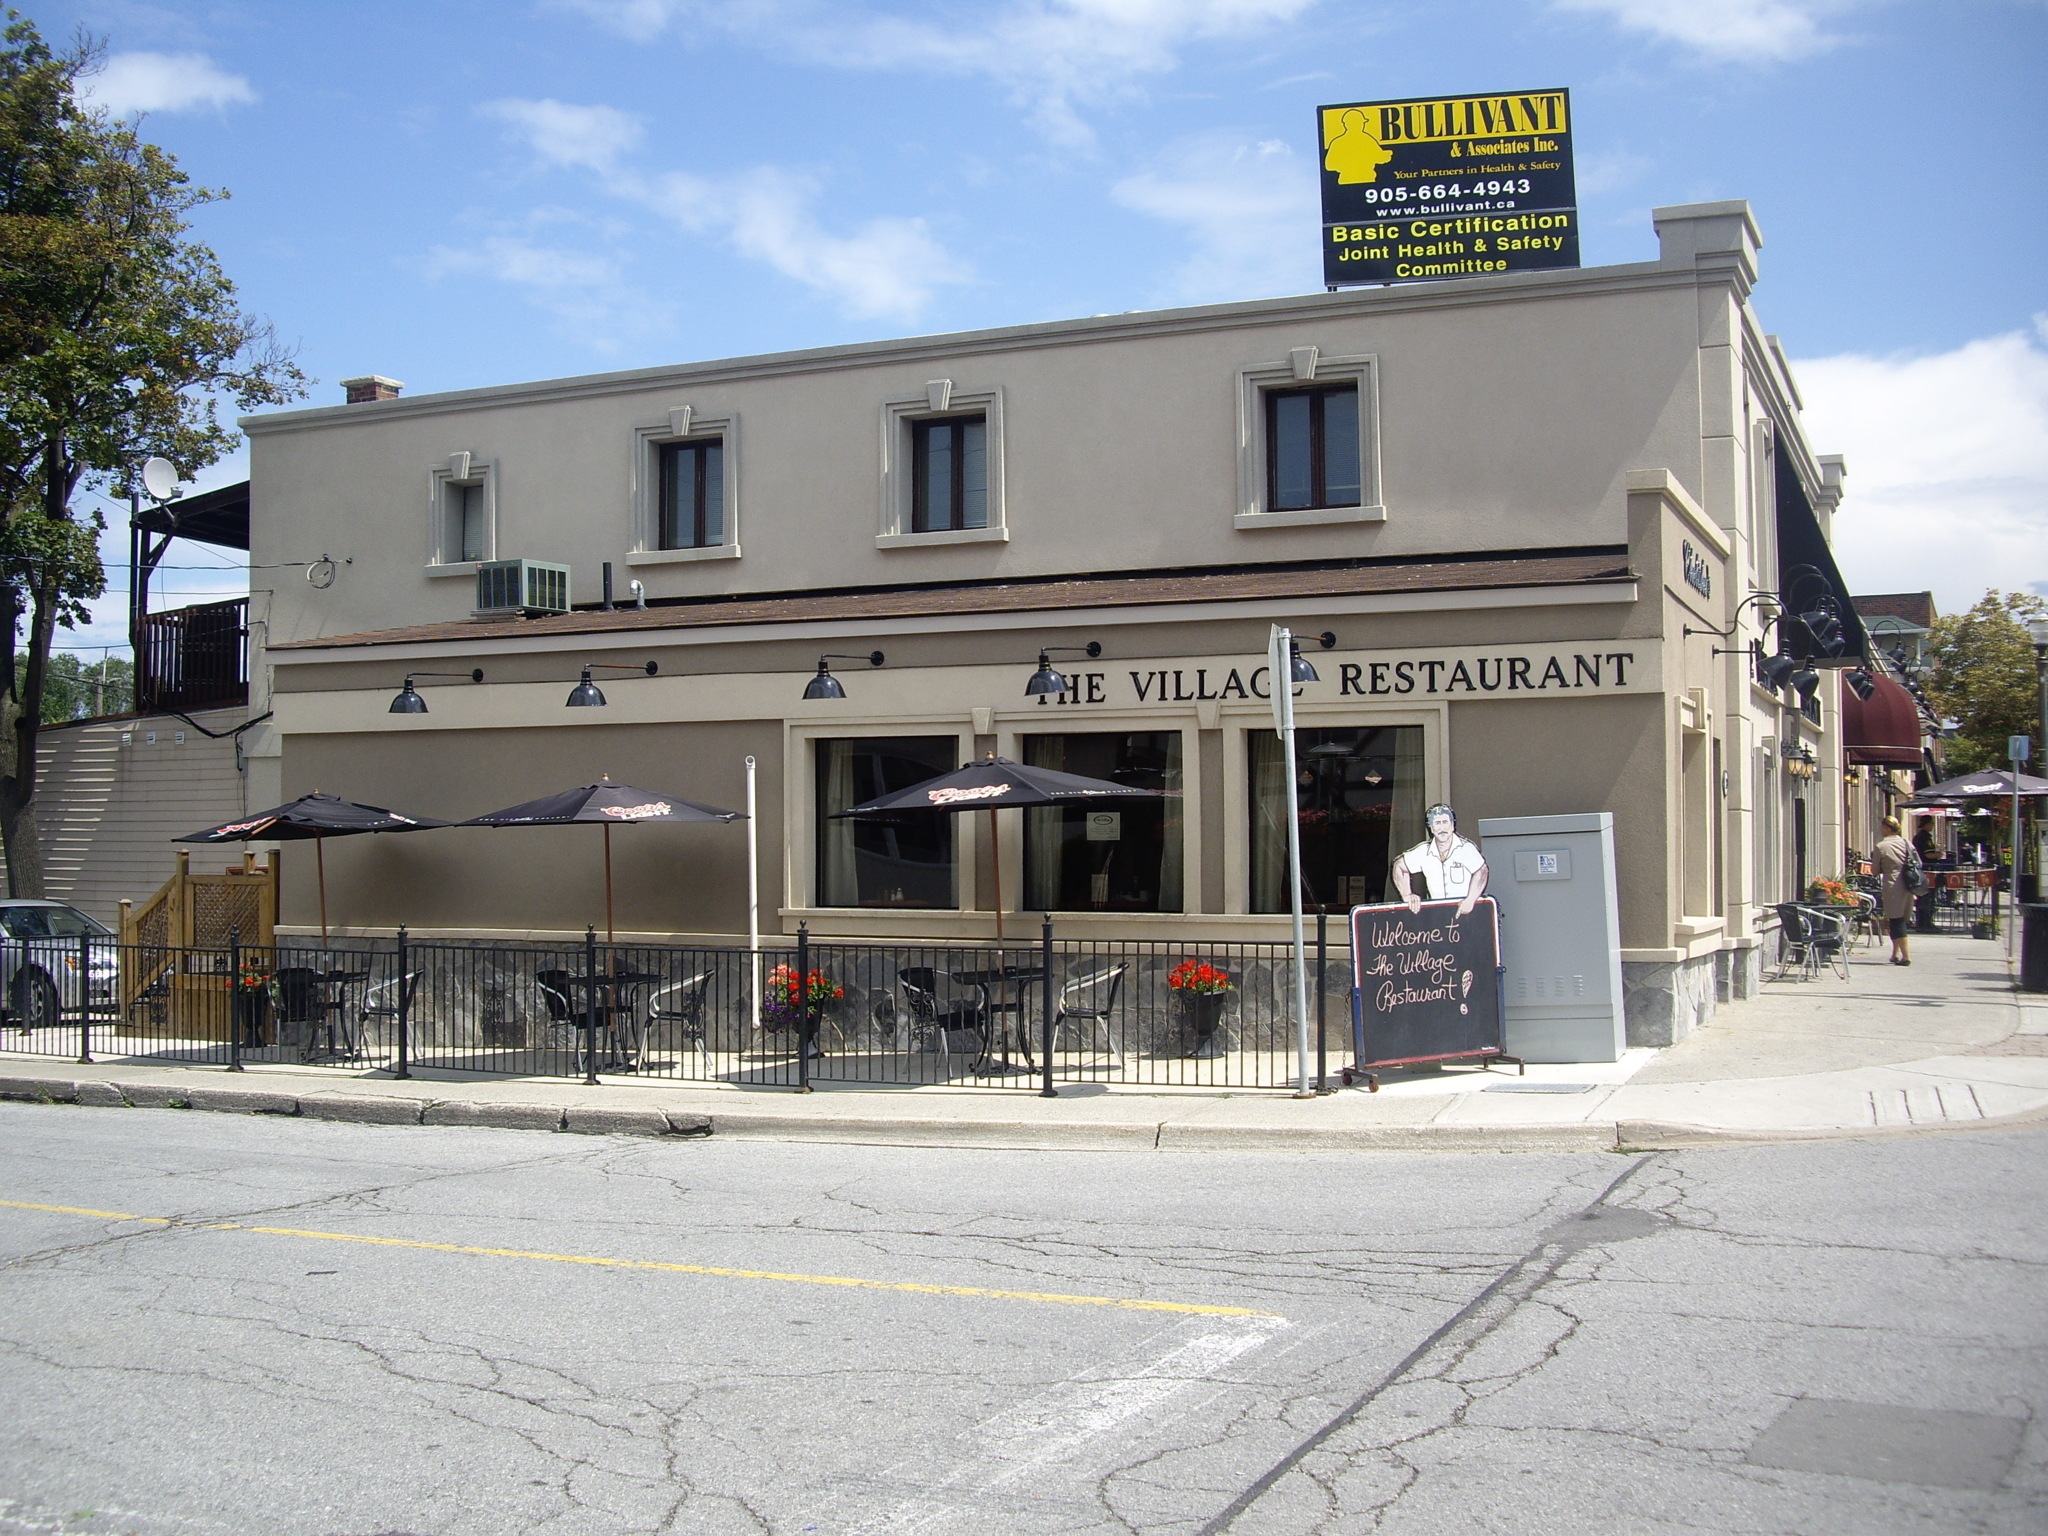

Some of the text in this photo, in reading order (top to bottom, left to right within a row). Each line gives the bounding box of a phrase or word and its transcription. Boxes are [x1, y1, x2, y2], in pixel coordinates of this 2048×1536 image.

[1379, 95, 1562, 141] BULLIVANT
[1450, 137, 1559, 158] & Associates Inc.
[1393, 160, 1561, 179] Your Partners in Health & Safety
[1365, 178, 1531, 204] 905-664-4943
[1376, 199, 1516, 218] www.bullivant.ca
[1332, 213, 1569, 243] Basic Certification
[1338, 234, 1564, 262] Joint Health & Safety
[1396, 258, 1508, 278] Committee
[1129, 667, 1304, 701] VILLAG
[1340, 652, 1634, 695] RESTAURANT
[1371, 918, 1460, 948] Welcome to
[1396, 950, 1457, 984] Village
